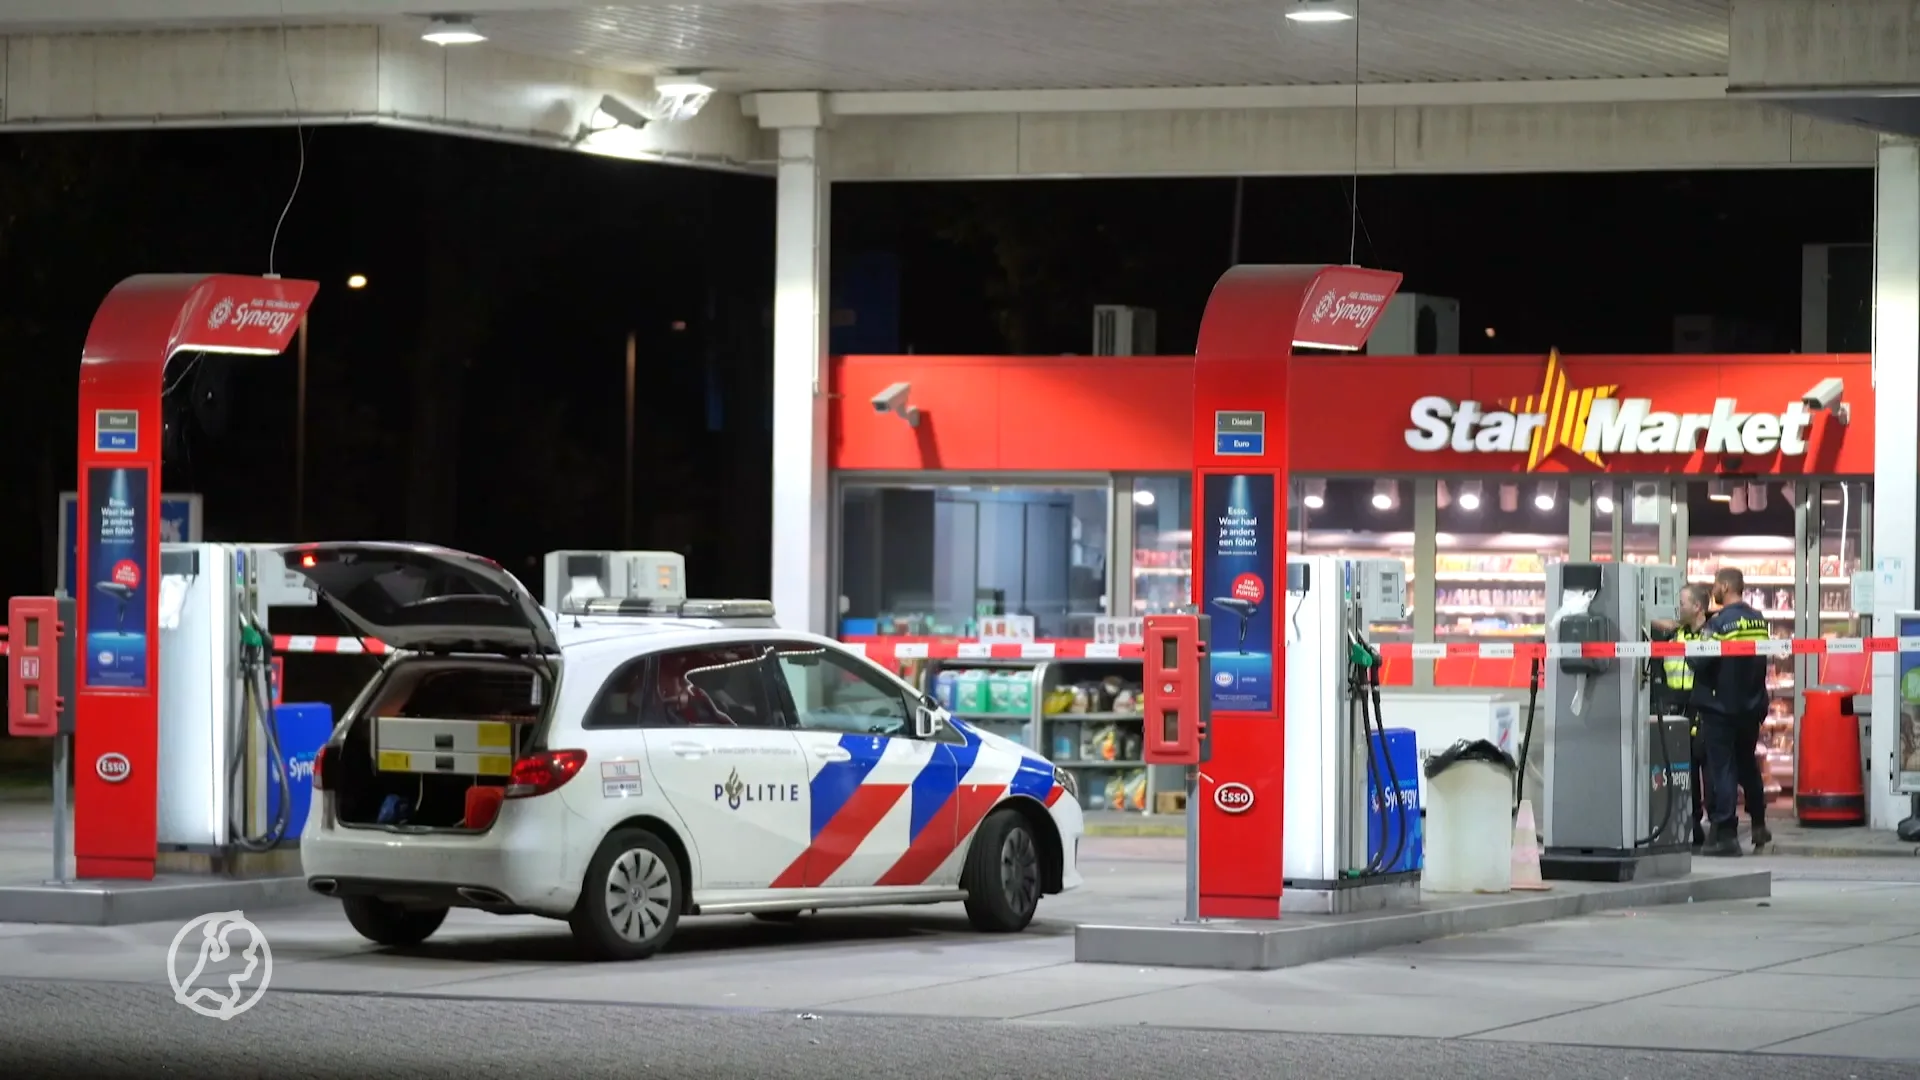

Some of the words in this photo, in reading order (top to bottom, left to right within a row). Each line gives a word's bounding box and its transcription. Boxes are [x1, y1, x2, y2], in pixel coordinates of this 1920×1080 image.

[231, 303, 295, 334] Synergy
[1329, 296, 1379, 329] Synergy
[1231, 418, 1253, 426] Diesel
[1404, 396, 1547, 452] Star
[1580, 397, 1811, 455] Market
[1233, 440, 1250, 448] Euro
[1228, 506, 1248, 516] Esso.
[1218, 517, 1239, 526] Waar
[1241, 516, 1257, 526] haal
[1220, 527, 1228, 538] je
[1229, 528, 1256, 537] anders
[1235, 538, 1257, 547] föhn?
[101, 759, 127, 773] Esso
[289, 756, 314, 782] Syne
[1662, 767, 1690, 791] Snergy
[714, 776, 799, 811] POLITIE
[1220, 789, 1249, 803] Esso
